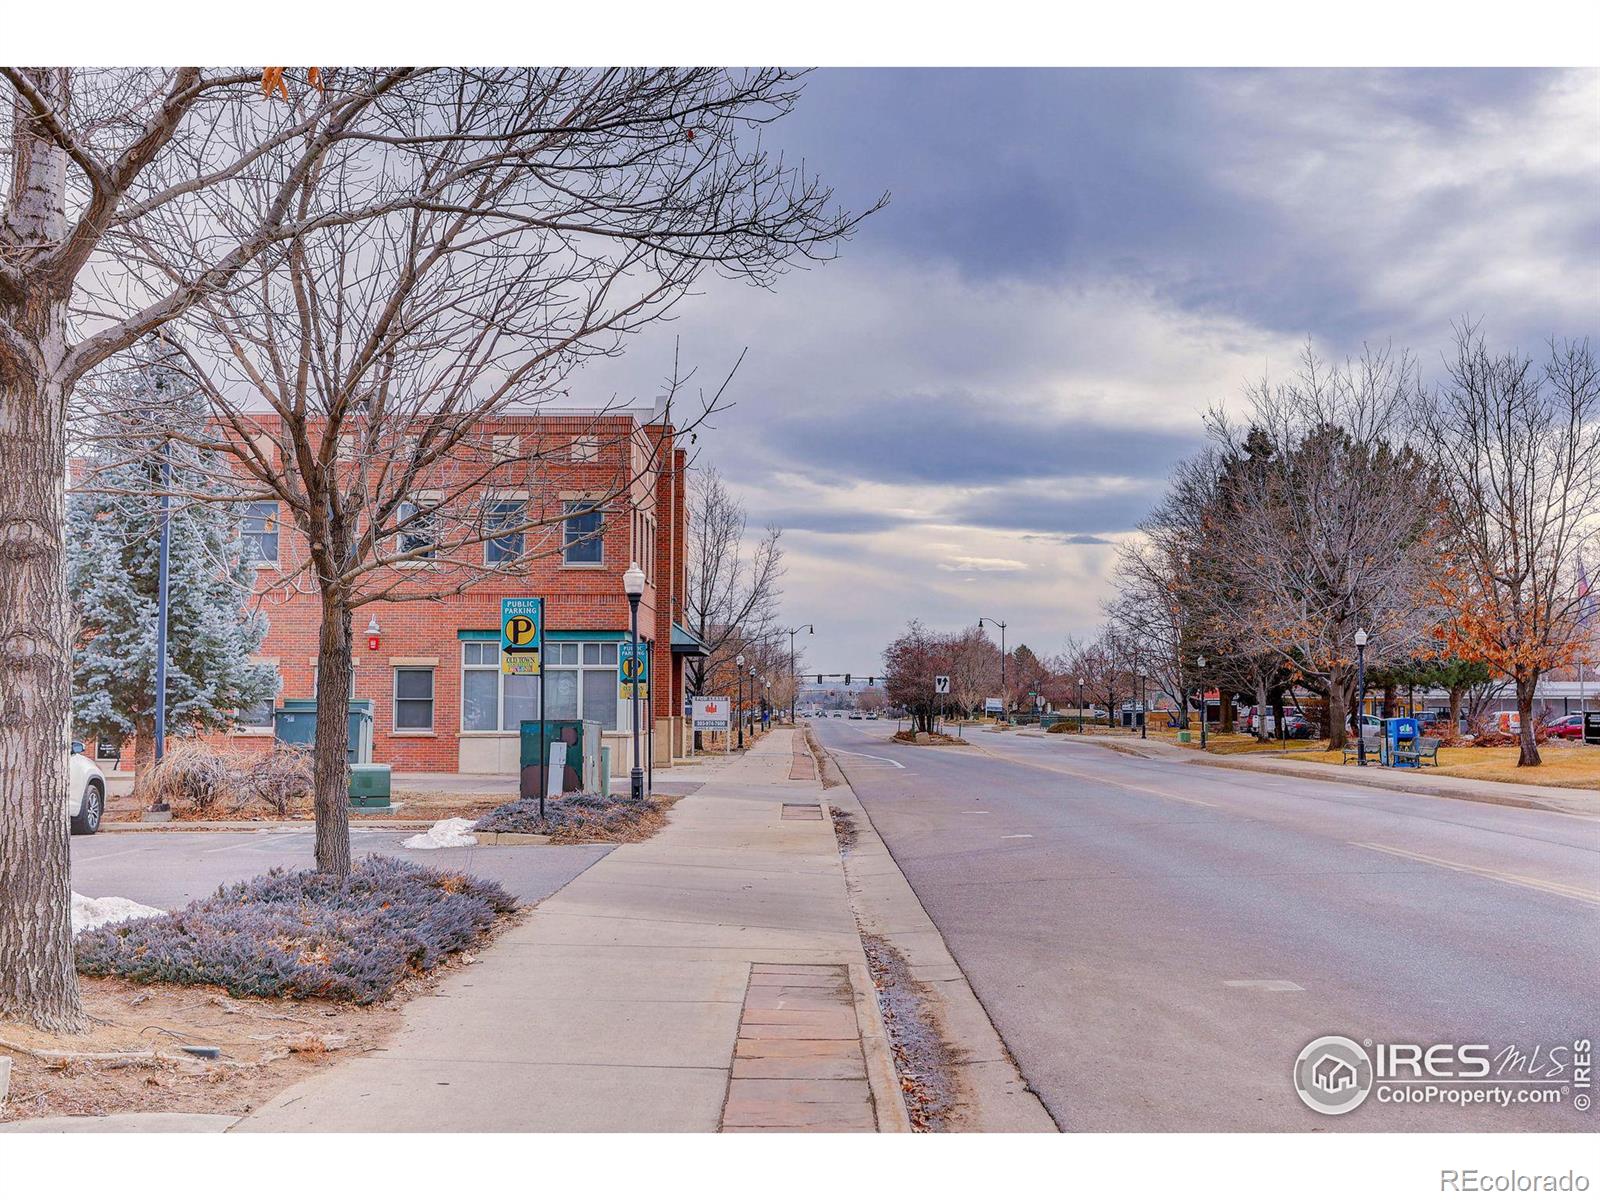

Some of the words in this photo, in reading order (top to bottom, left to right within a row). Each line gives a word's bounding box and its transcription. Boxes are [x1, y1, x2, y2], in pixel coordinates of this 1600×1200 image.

[507, 600, 534, 608] PUBLIC
[504, 607, 537, 615] PARKING
[509, 618, 532, 645] P
